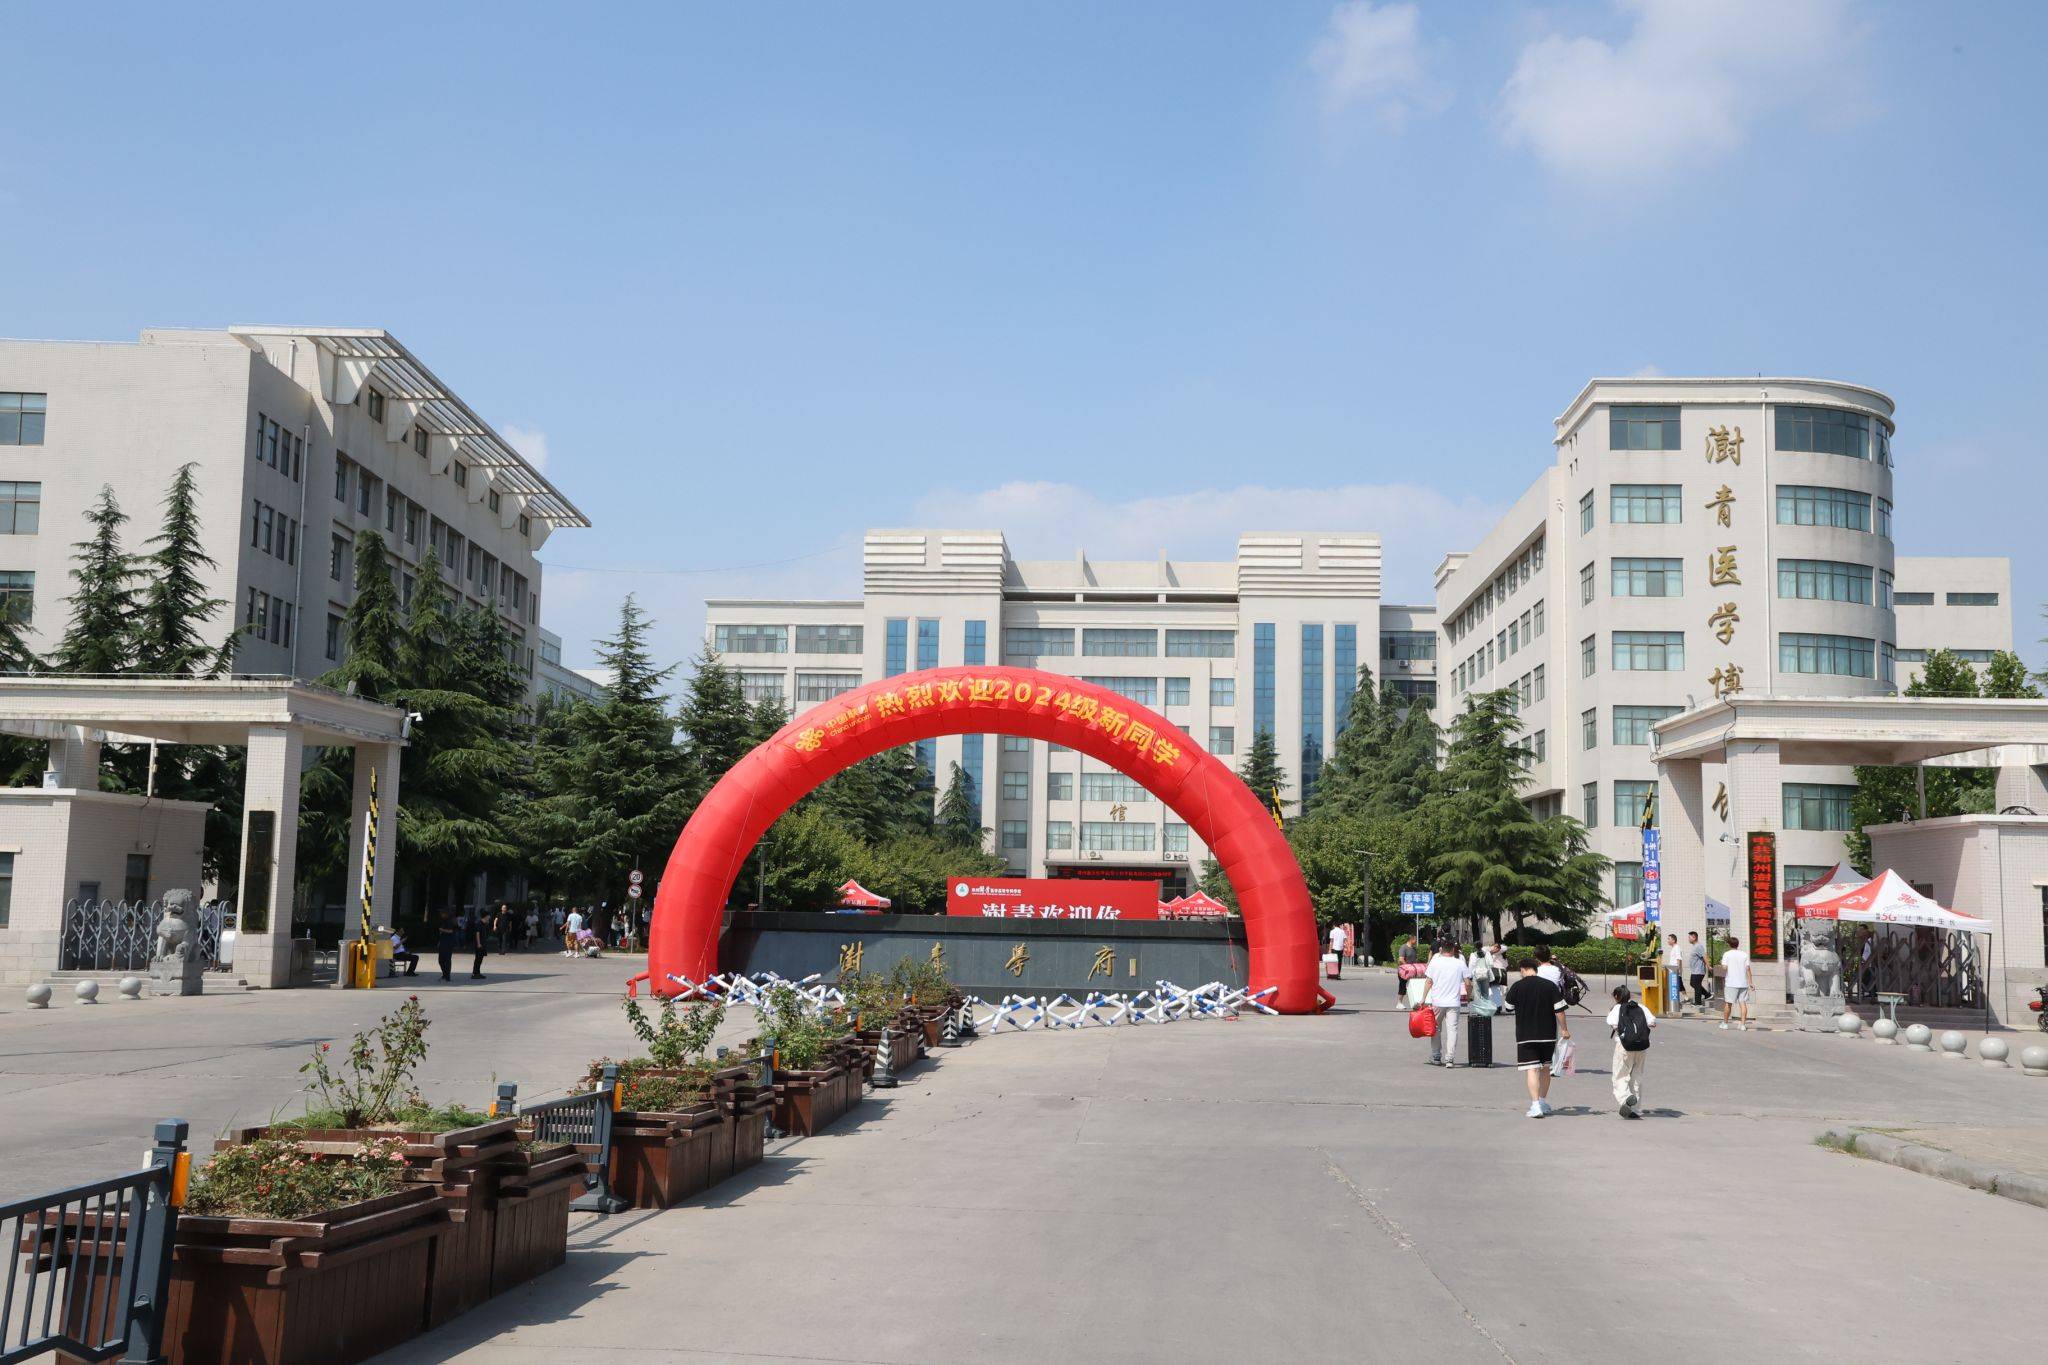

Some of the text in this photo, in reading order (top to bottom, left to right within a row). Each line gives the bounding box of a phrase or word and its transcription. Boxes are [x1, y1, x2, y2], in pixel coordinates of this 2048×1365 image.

[1704, 424, 1744, 819] 澍青医学博
[875, 678, 1181, 766] 热烈欢迎2024级新同学
[1404, 893, 1431, 903] 停车场
